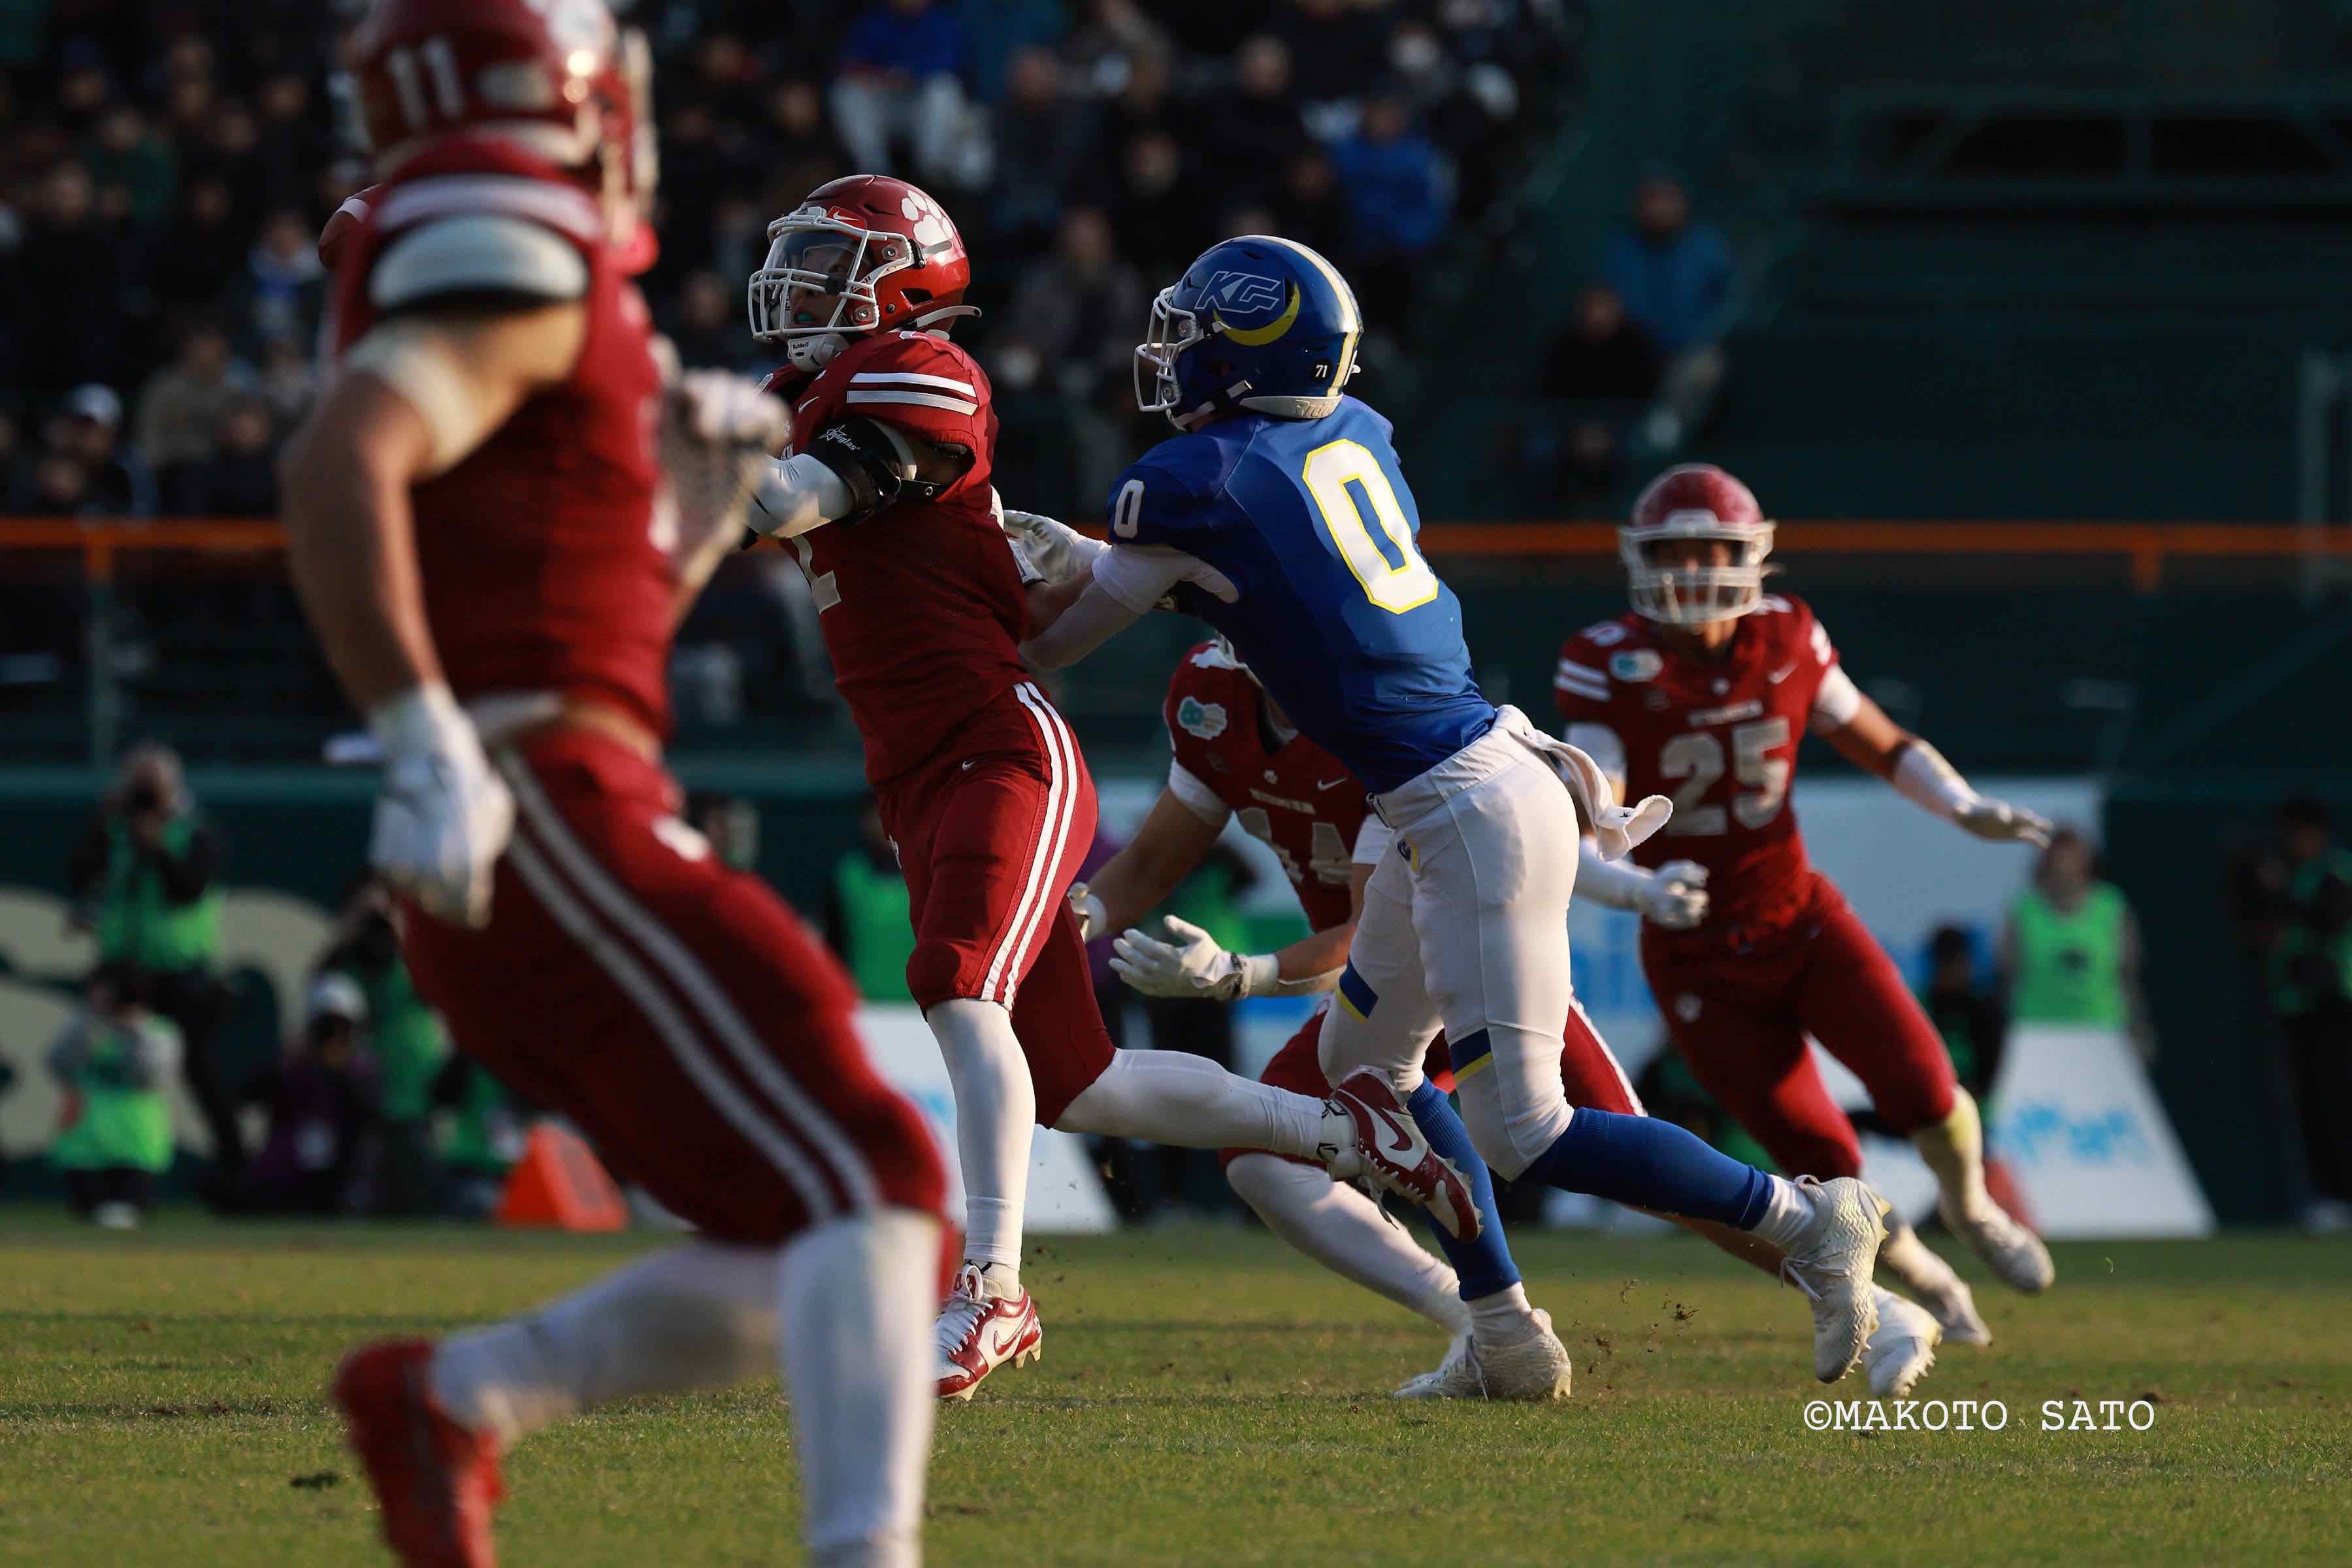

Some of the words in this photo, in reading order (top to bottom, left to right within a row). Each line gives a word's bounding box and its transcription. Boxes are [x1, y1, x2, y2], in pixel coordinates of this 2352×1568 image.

[387, 33, 466, 132] 11
[1315, 364, 1329, 378] 71
[1113, 479, 1144, 539] 0
[1302, 438, 1439, 615] 0
[1658, 716, 1791, 837] 25
